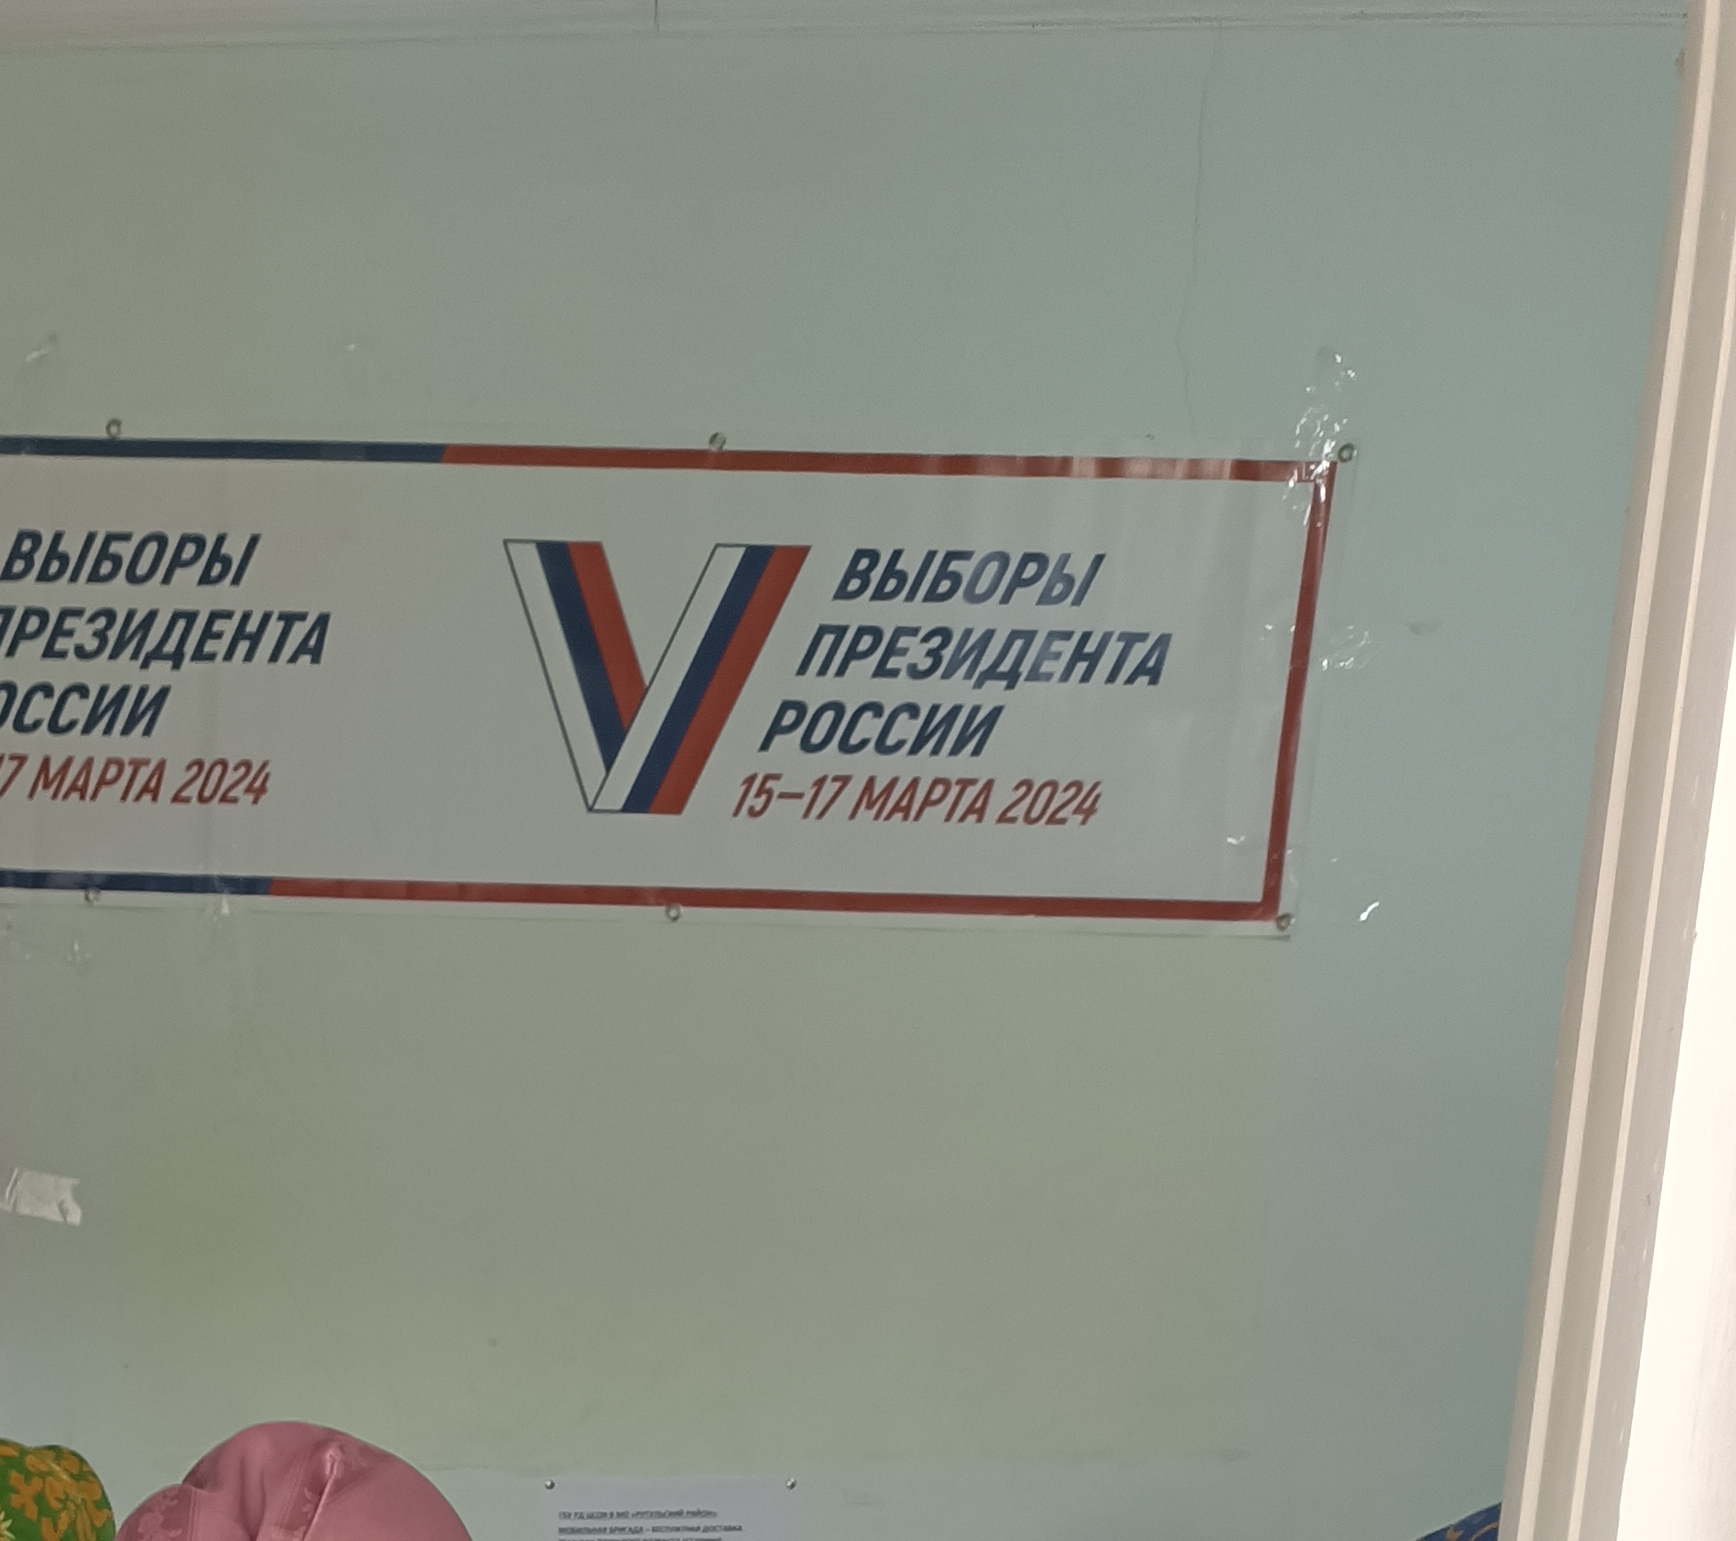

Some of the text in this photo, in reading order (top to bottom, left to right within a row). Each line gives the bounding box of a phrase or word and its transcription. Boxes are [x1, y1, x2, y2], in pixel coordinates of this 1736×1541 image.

[832, 547, 1107, 607] ВЫБОРЫ
[795, 623, 1173, 691] ПРЕЗИДЕНТА
[758, 699, 1005, 757] РОССИИ
[27, 754, 168, 802] МАРТА
[170, 757, 271, 805] 2024
[848, 775, 996, 823] МАРТА
[995, 778, 1103, 826] 2024
